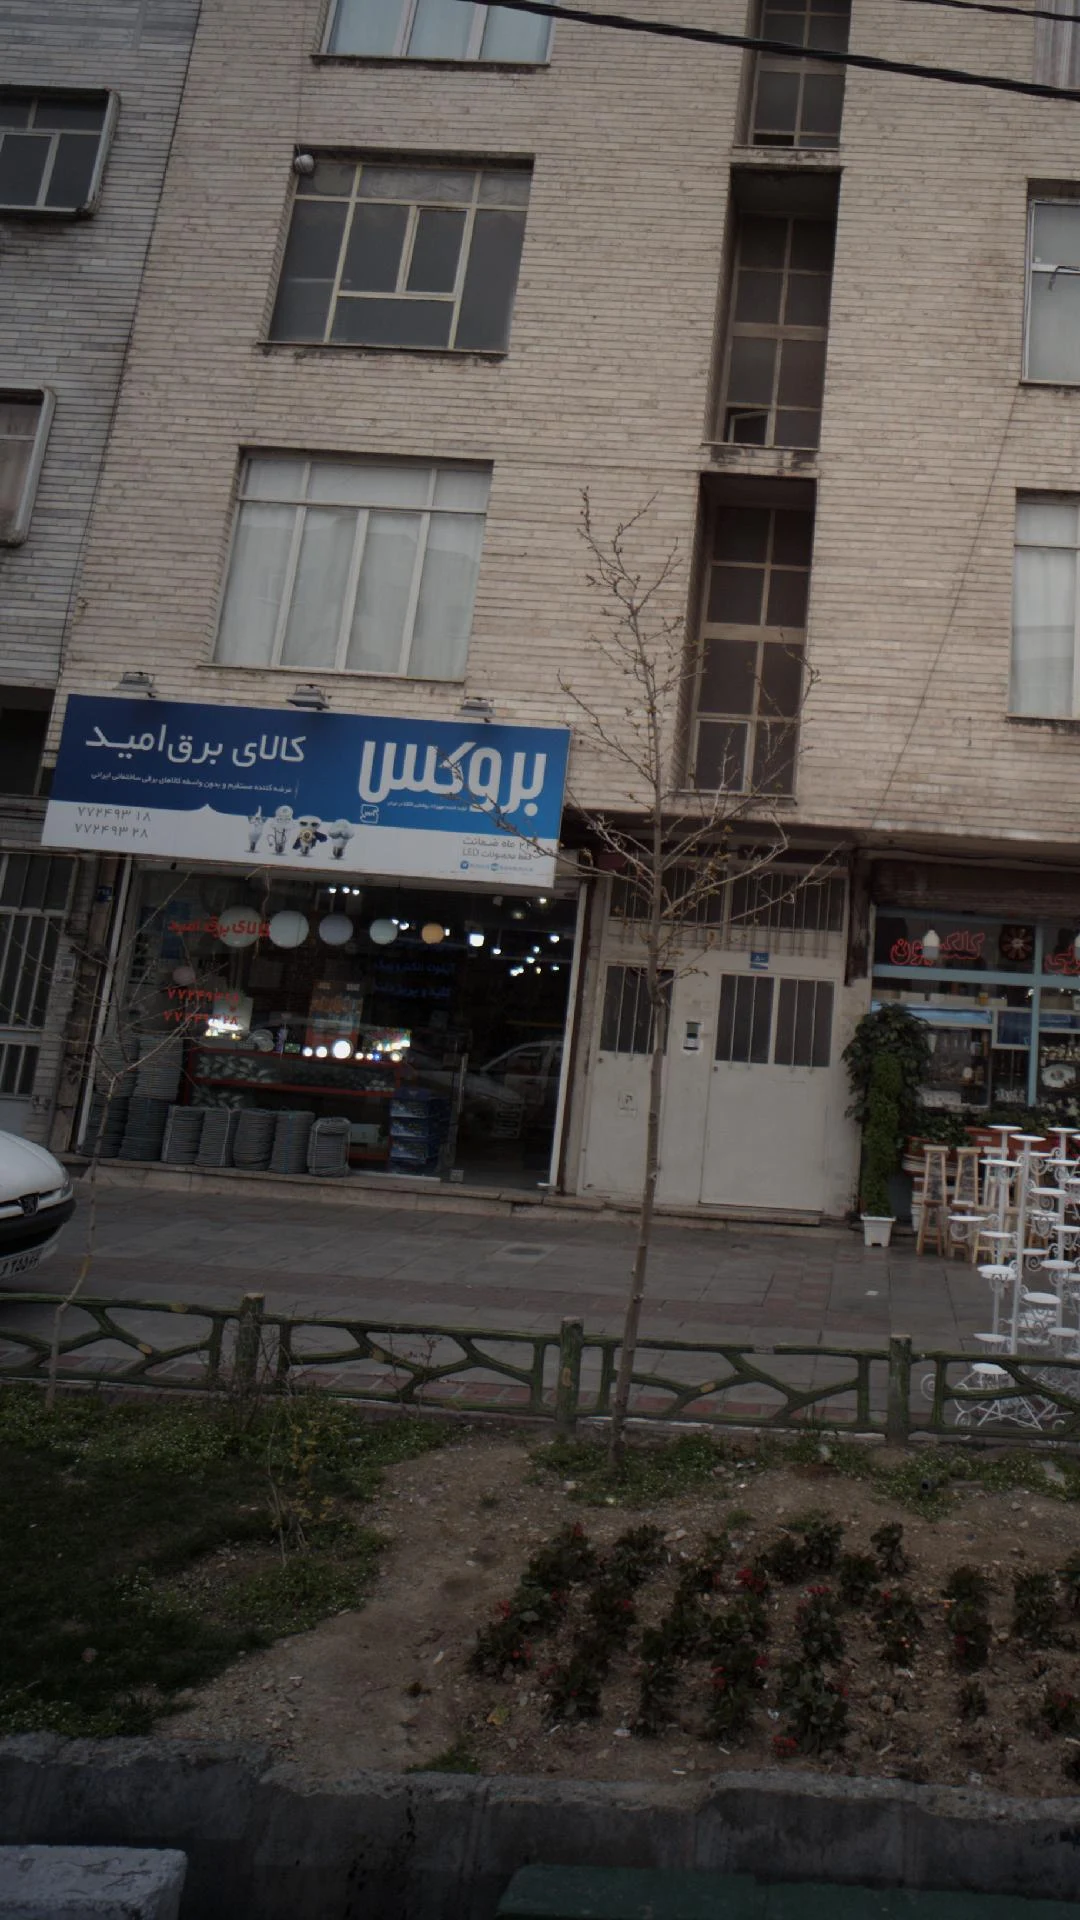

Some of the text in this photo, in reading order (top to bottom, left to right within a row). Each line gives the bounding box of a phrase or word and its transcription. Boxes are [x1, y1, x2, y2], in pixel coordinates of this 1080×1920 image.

[85, 724, 307, 768] کالای برق امید
[91, 771, 111, 780] ایرانی
[111, 771, 142, 781] ساختمانی
[142, 775, 158, 784] برقی
[358, 740, 547, 817] بروکس
[182, 778, 203, 788] واسطه
[203, 781, 221, 789] بدون
[227, 782, 253, 791] مستقیم
[463, 836, 499, 847] ضمانت
[232, 919, 271, 937] کالای
